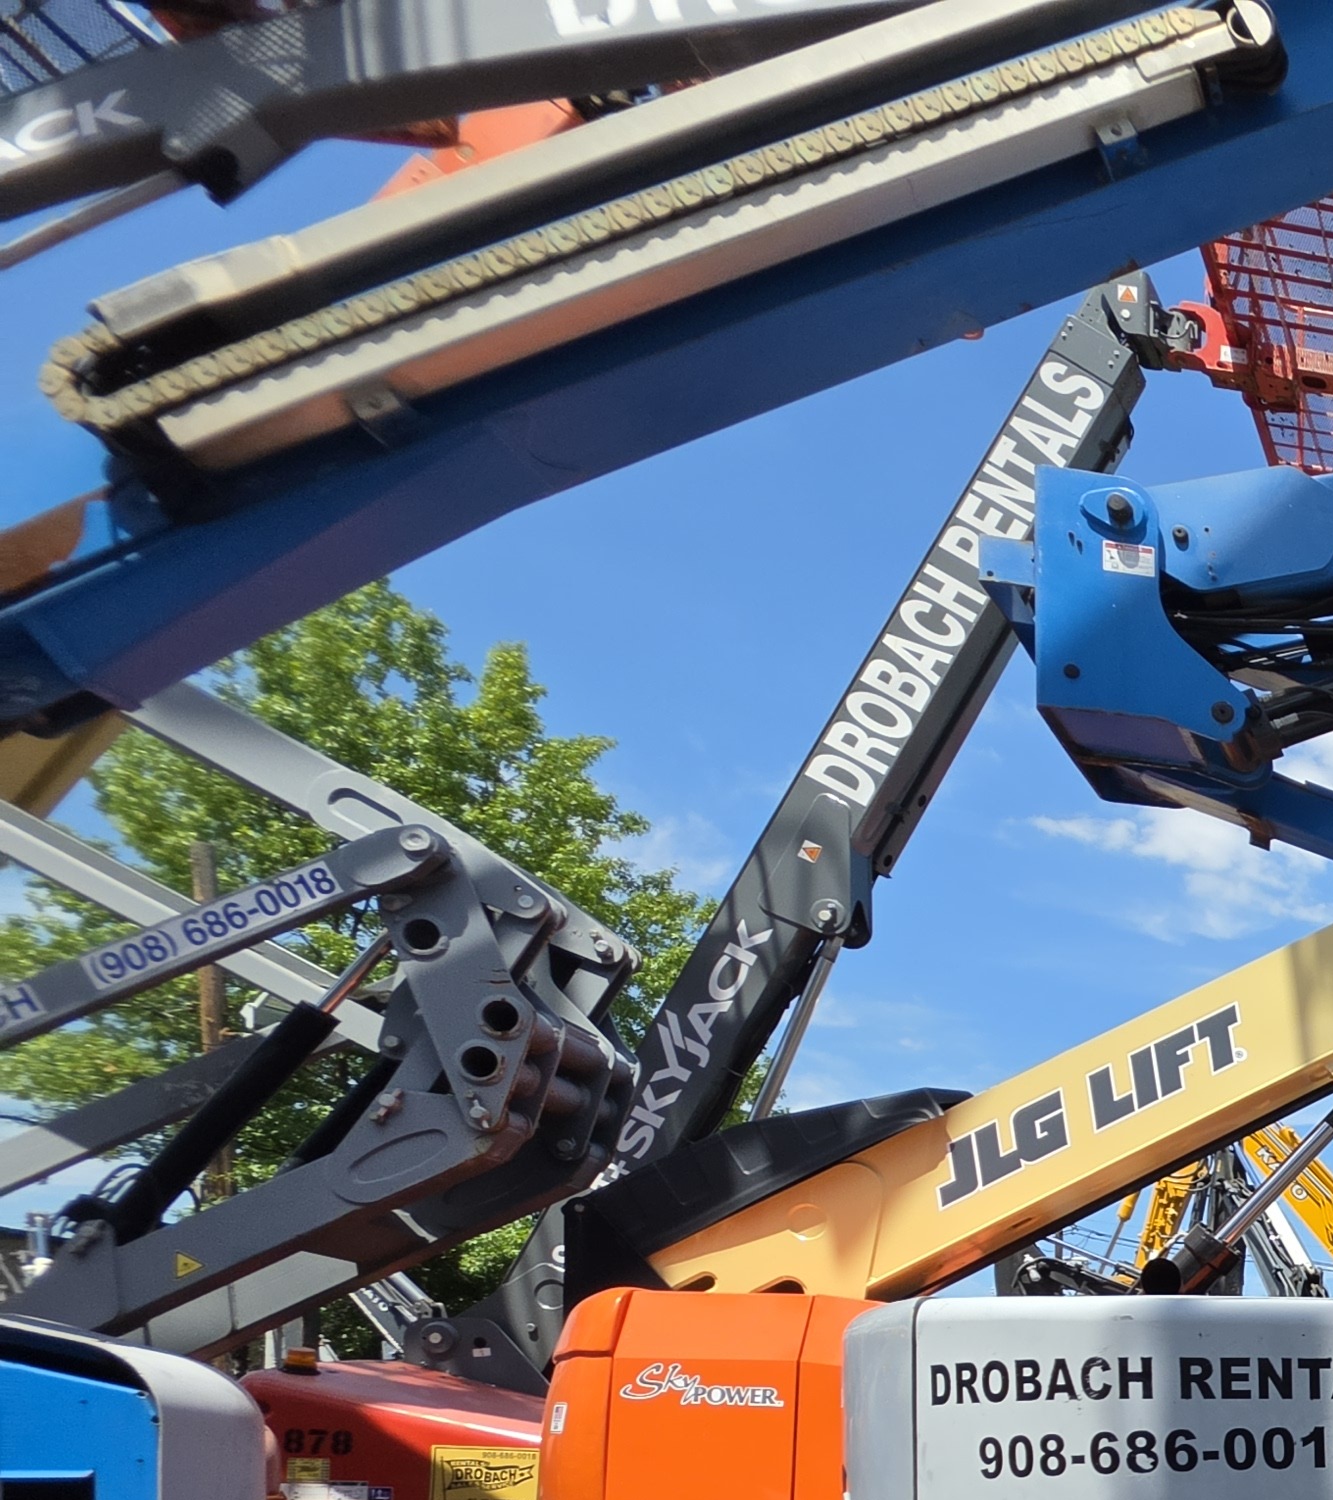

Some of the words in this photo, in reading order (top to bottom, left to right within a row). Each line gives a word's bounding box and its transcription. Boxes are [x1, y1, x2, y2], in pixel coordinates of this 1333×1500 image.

[804, 564, 989, 807] DROBACH
[92, 930, 179, 983] (908)
[182, 866, 337, 947] 686-0018
[616, 919, 773, 1159] SKYJACK
[936, 1086, 1072, 1211] JLG
[1086, 1001, 1242, 1134] LIFT
[930, 1356, 1154, 1405] DROBACH
[283, 1428, 354, 1456] 878
[454, 1468, 517, 1483] DROBACH
